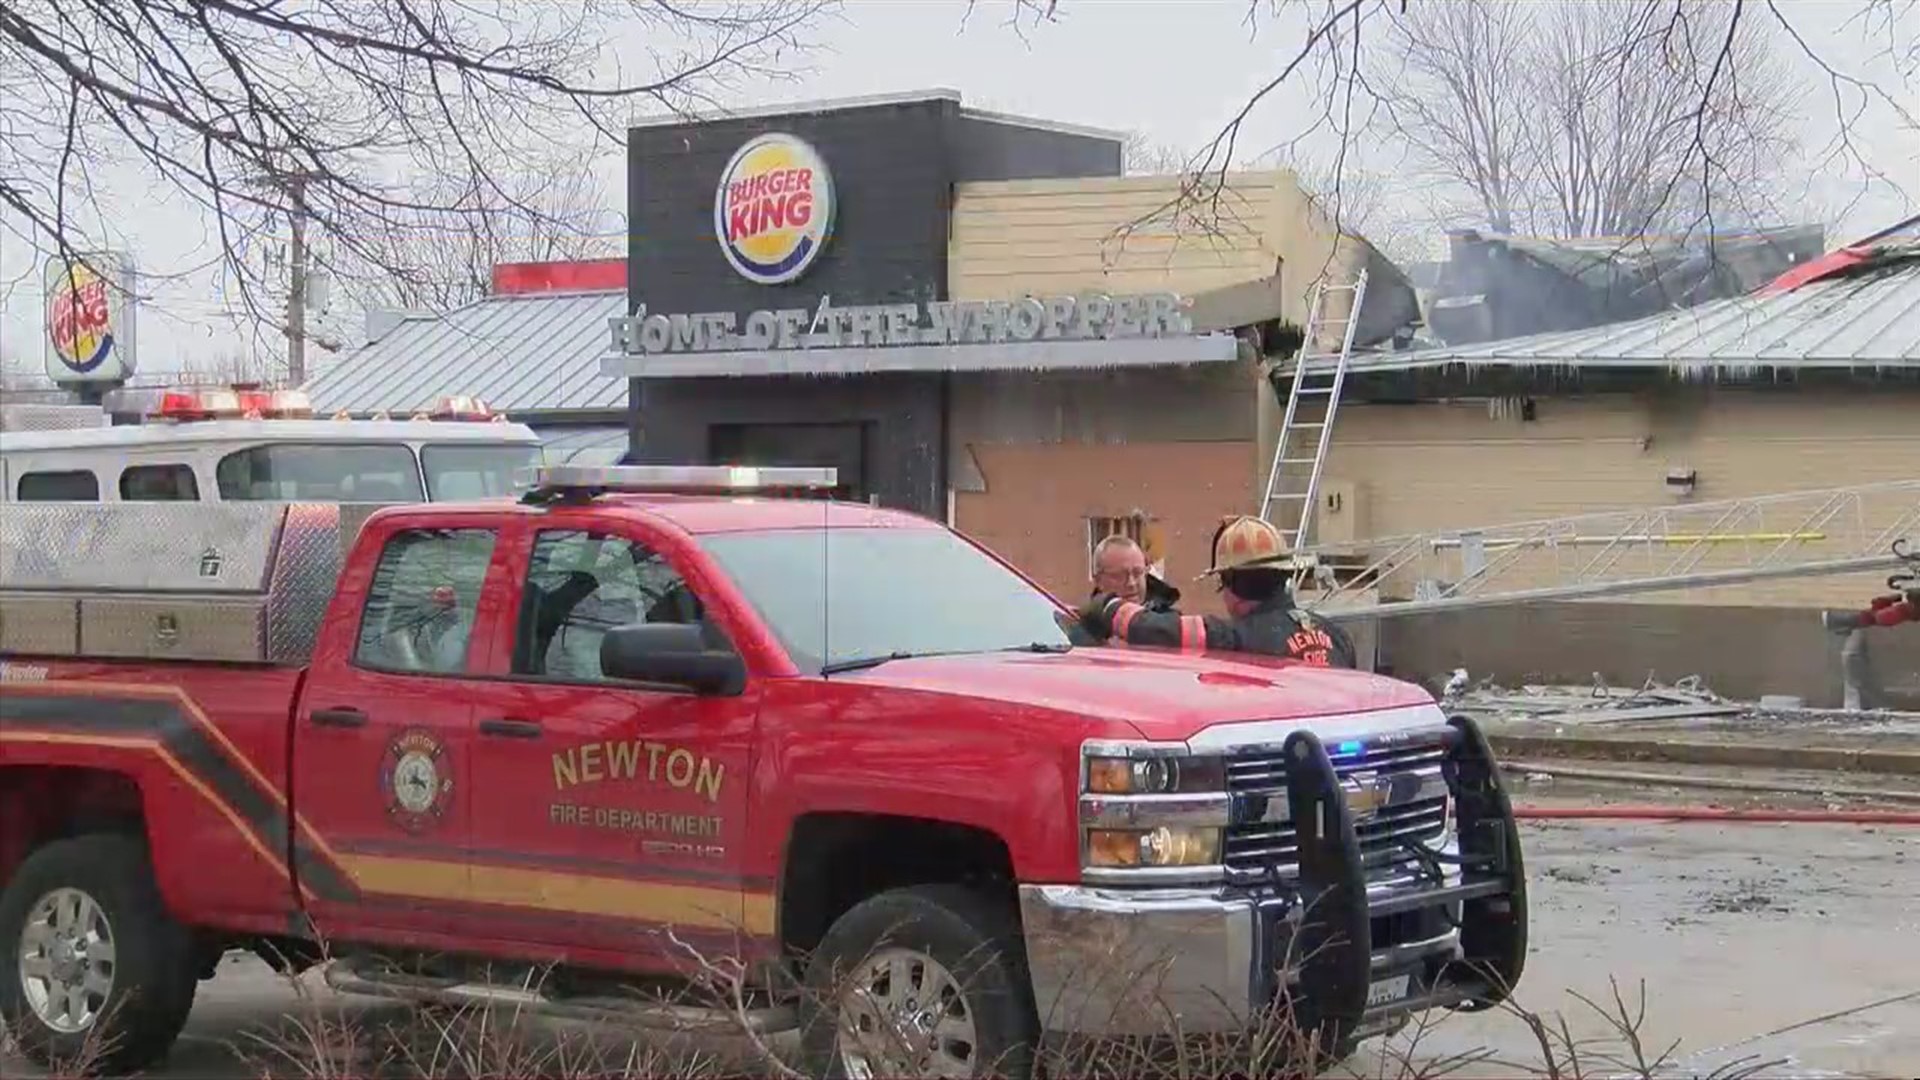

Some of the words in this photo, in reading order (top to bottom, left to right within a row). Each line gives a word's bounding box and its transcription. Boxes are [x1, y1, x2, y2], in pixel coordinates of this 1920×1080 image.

[730, 169, 812, 206] BURGER
[730, 193, 812, 241] KING
[55, 300, 108, 348] KING
[608, 312, 736, 352] HOME
[746, 309, 808, 350] OF
[820, 303, 917, 348] THE
[927, 293, 1192, 343] WHOPPER
[1287, 630, 1333, 654] NEWTON
[552, 740, 725, 801] NEWTON
[550, 804, 590, 825] FIRE
[595, 809, 723, 836] DEPARTMENT
